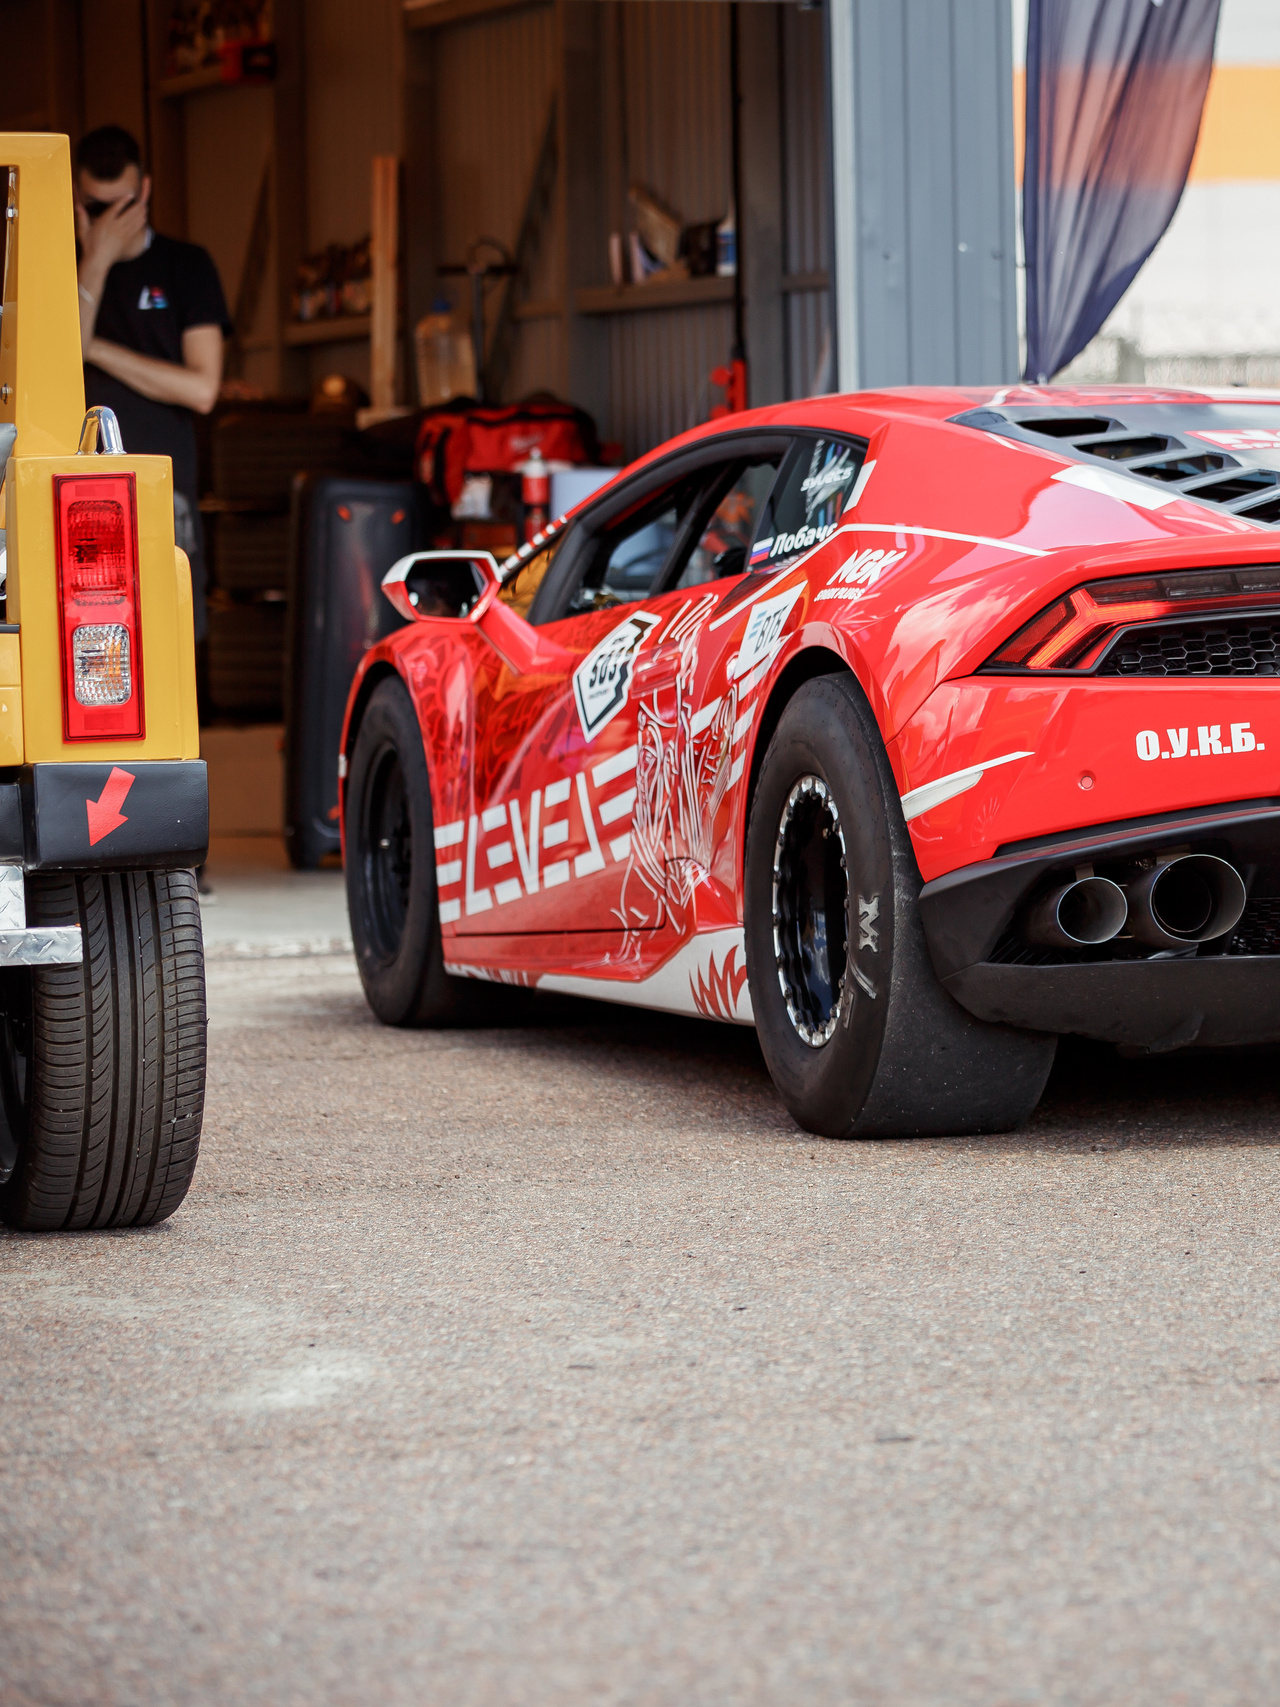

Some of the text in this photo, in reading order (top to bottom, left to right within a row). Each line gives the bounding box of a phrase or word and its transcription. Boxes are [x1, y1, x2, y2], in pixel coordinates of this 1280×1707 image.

[826, 549, 907, 586] NGK
[834, 587, 865, 600] PLUGS
[755, 604, 789, 653] ВТБ
[1135, 722, 1265, 761] О.У.К.Б.
